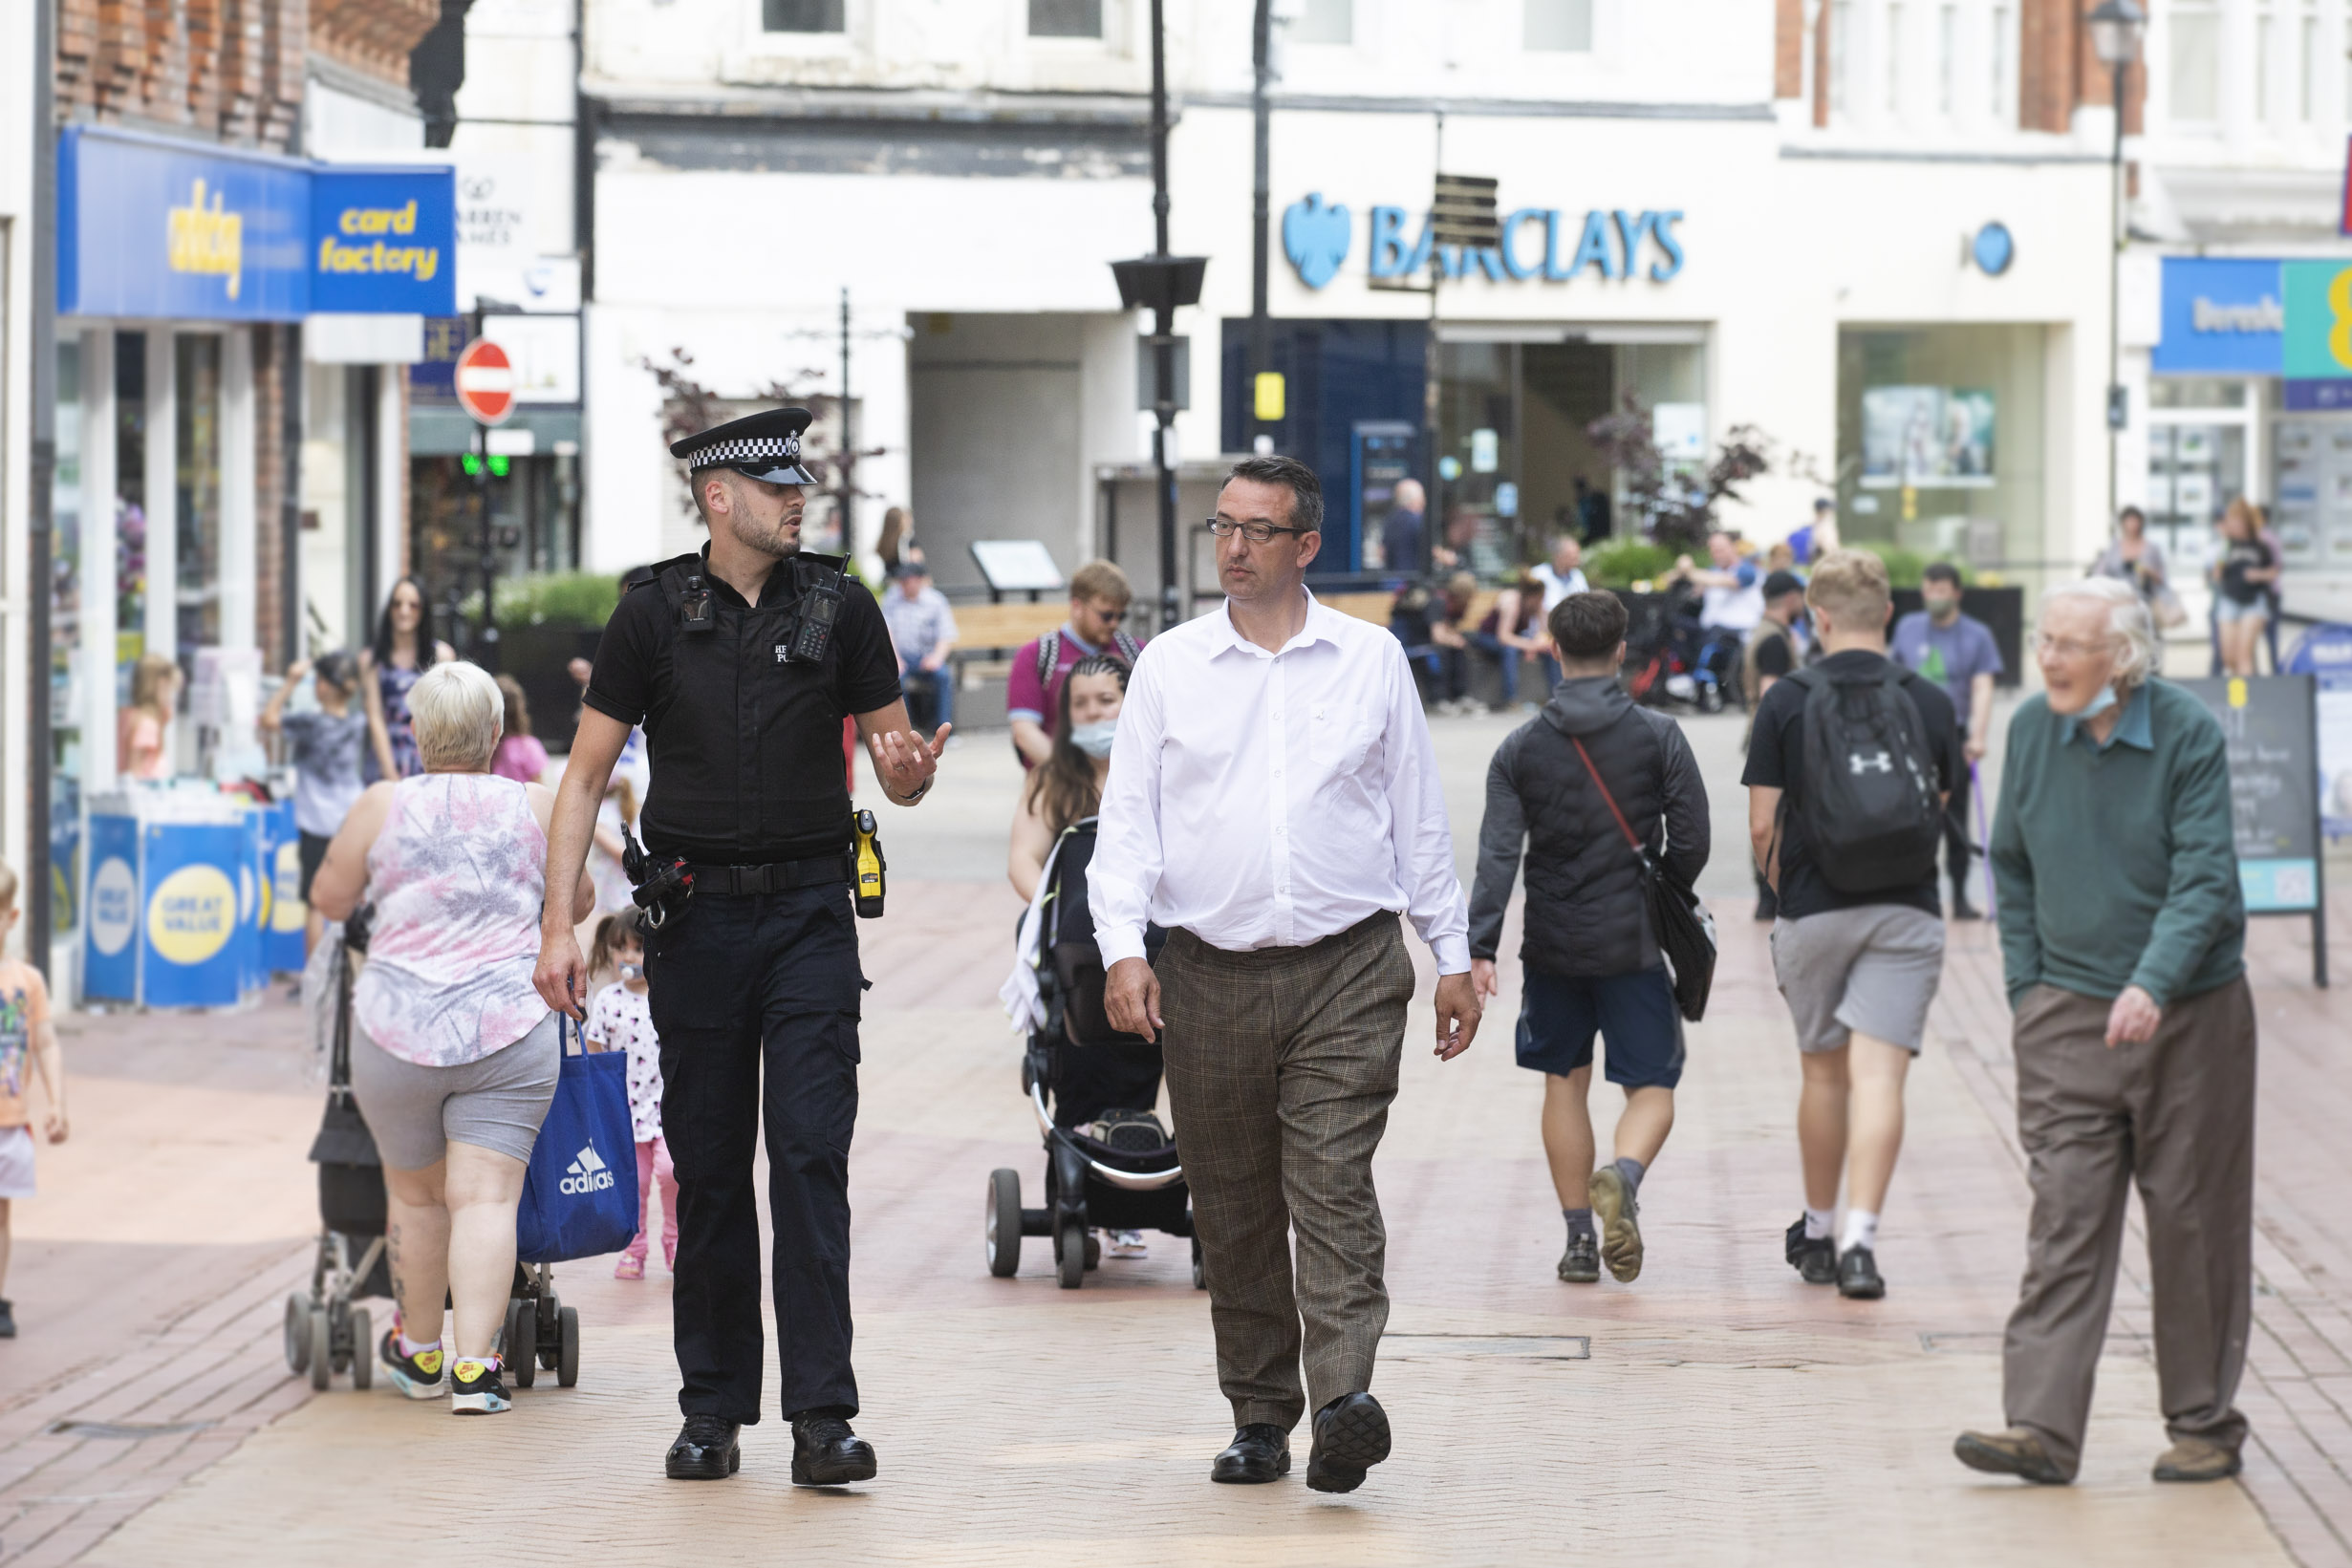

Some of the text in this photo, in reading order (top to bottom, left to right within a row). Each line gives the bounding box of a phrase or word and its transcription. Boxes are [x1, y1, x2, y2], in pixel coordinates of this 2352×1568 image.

[340, 199, 418, 235] card
[319, 236, 439, 281] factory
[161, 896, 224, 913] GREAT
[162, 915, 223, 933] VALUE
